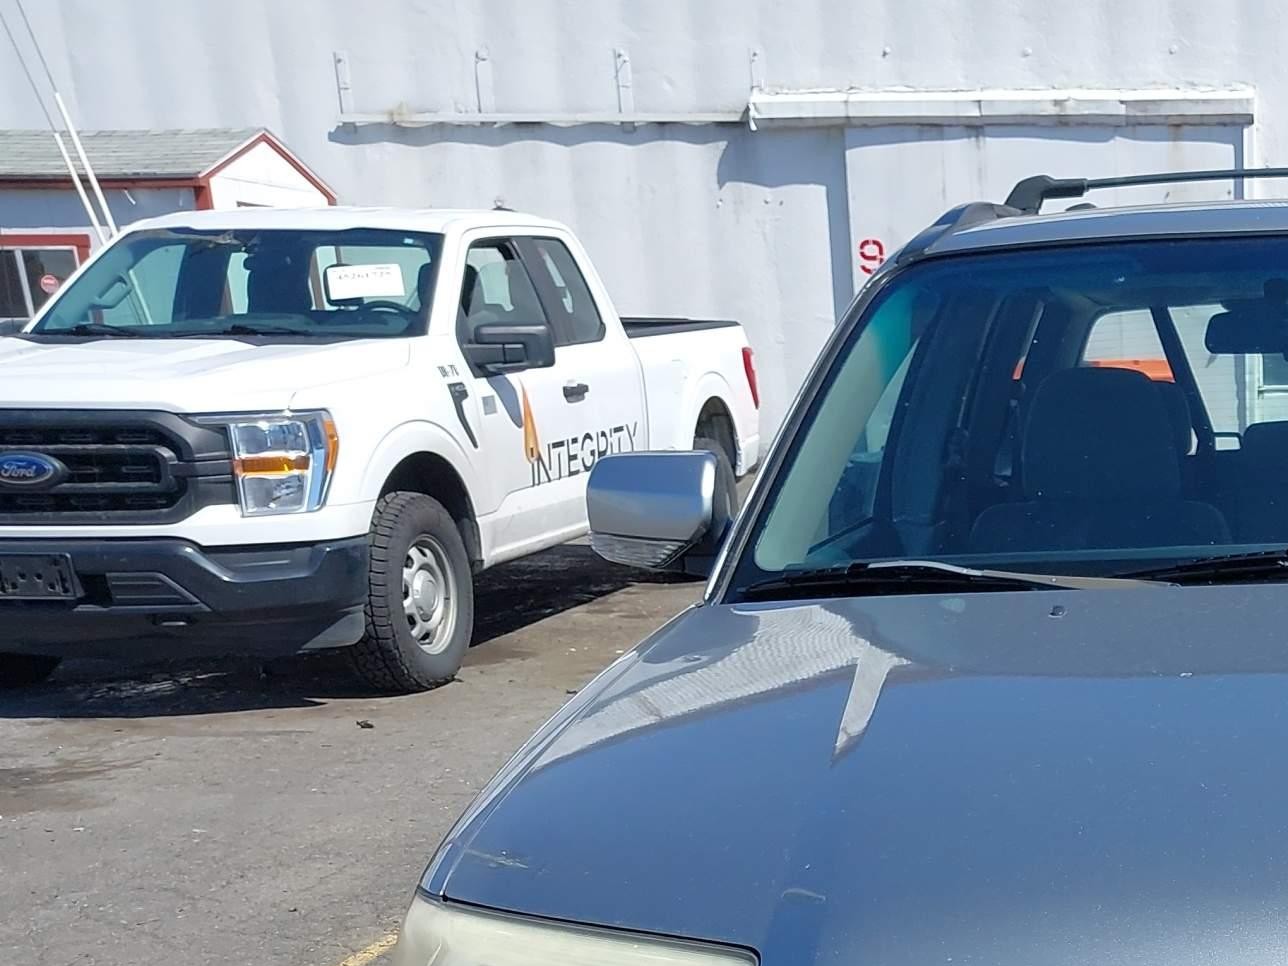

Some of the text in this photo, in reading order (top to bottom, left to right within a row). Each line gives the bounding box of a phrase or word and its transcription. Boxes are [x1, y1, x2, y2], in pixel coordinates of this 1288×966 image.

[859, 239, 884, 275] 9
[0, 461, 37, 478] Ford
[529, 421, 639, 487] INTEGRITY
